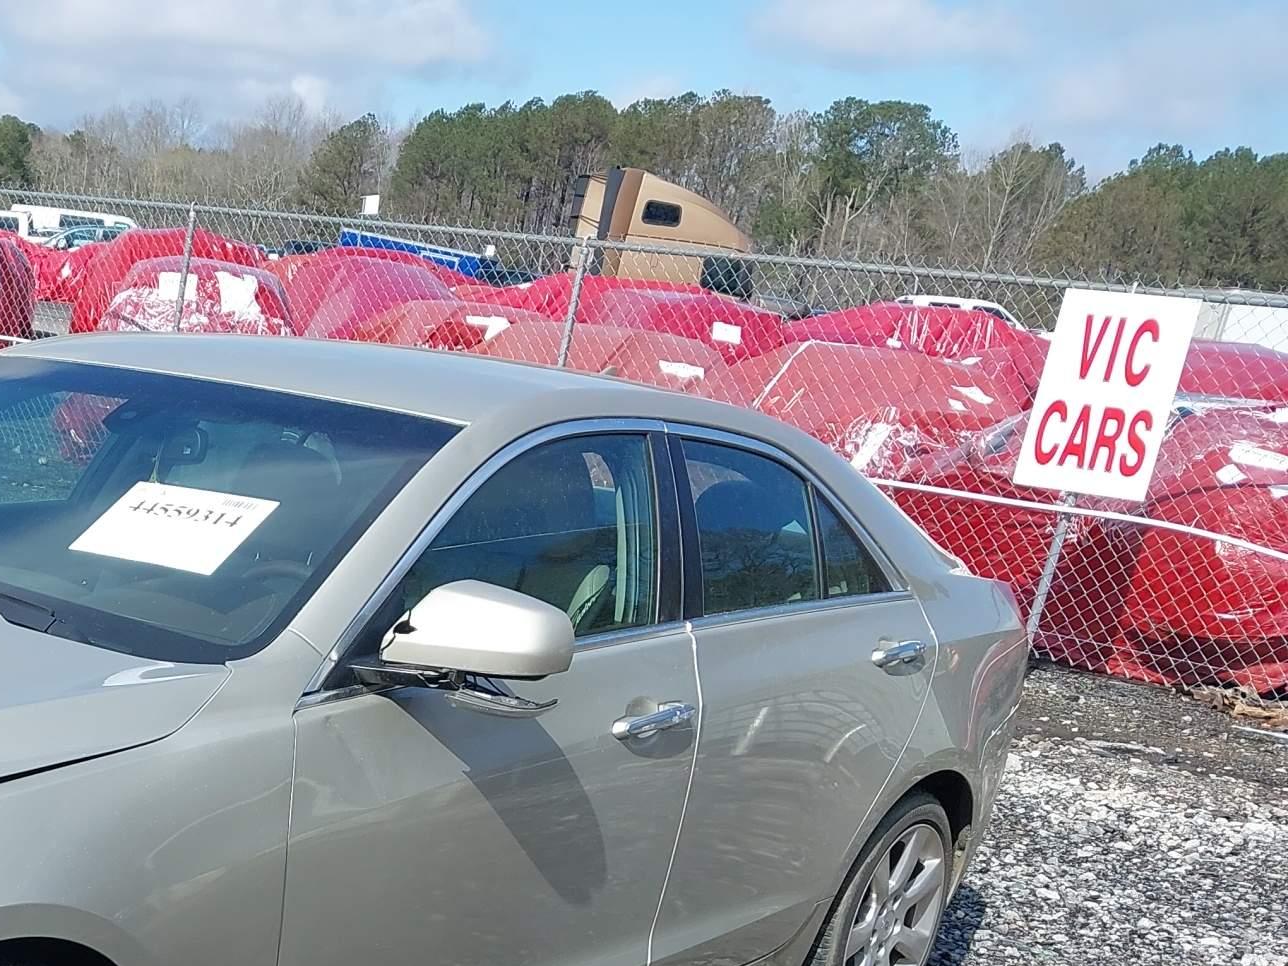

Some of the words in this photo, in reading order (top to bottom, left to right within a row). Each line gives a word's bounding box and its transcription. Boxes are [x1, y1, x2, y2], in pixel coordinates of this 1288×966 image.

[1079, 314, 1160, 387] VIC
[1034, 400, 1153, 477] CARS
[128, 500, 243, 527] 44559314
